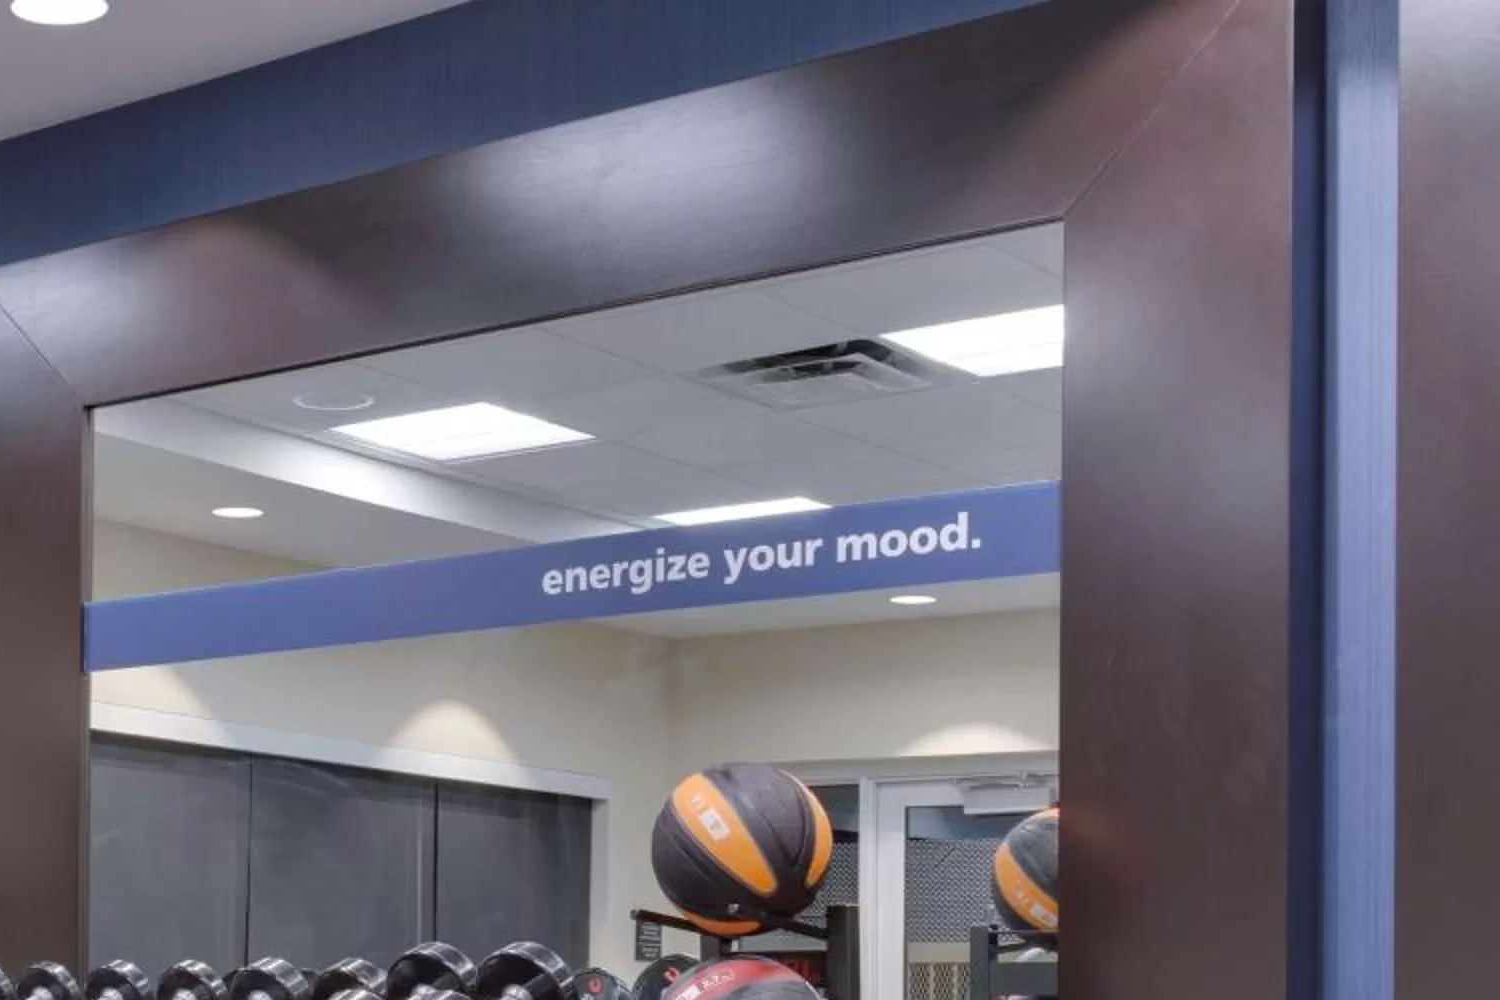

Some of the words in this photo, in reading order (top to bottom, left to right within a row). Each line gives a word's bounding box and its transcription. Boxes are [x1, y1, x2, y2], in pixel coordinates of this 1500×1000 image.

[541, 548, 710, 595] energize
[723, 538, 822, 584] your
[836, 511, 982, 563] mood.
